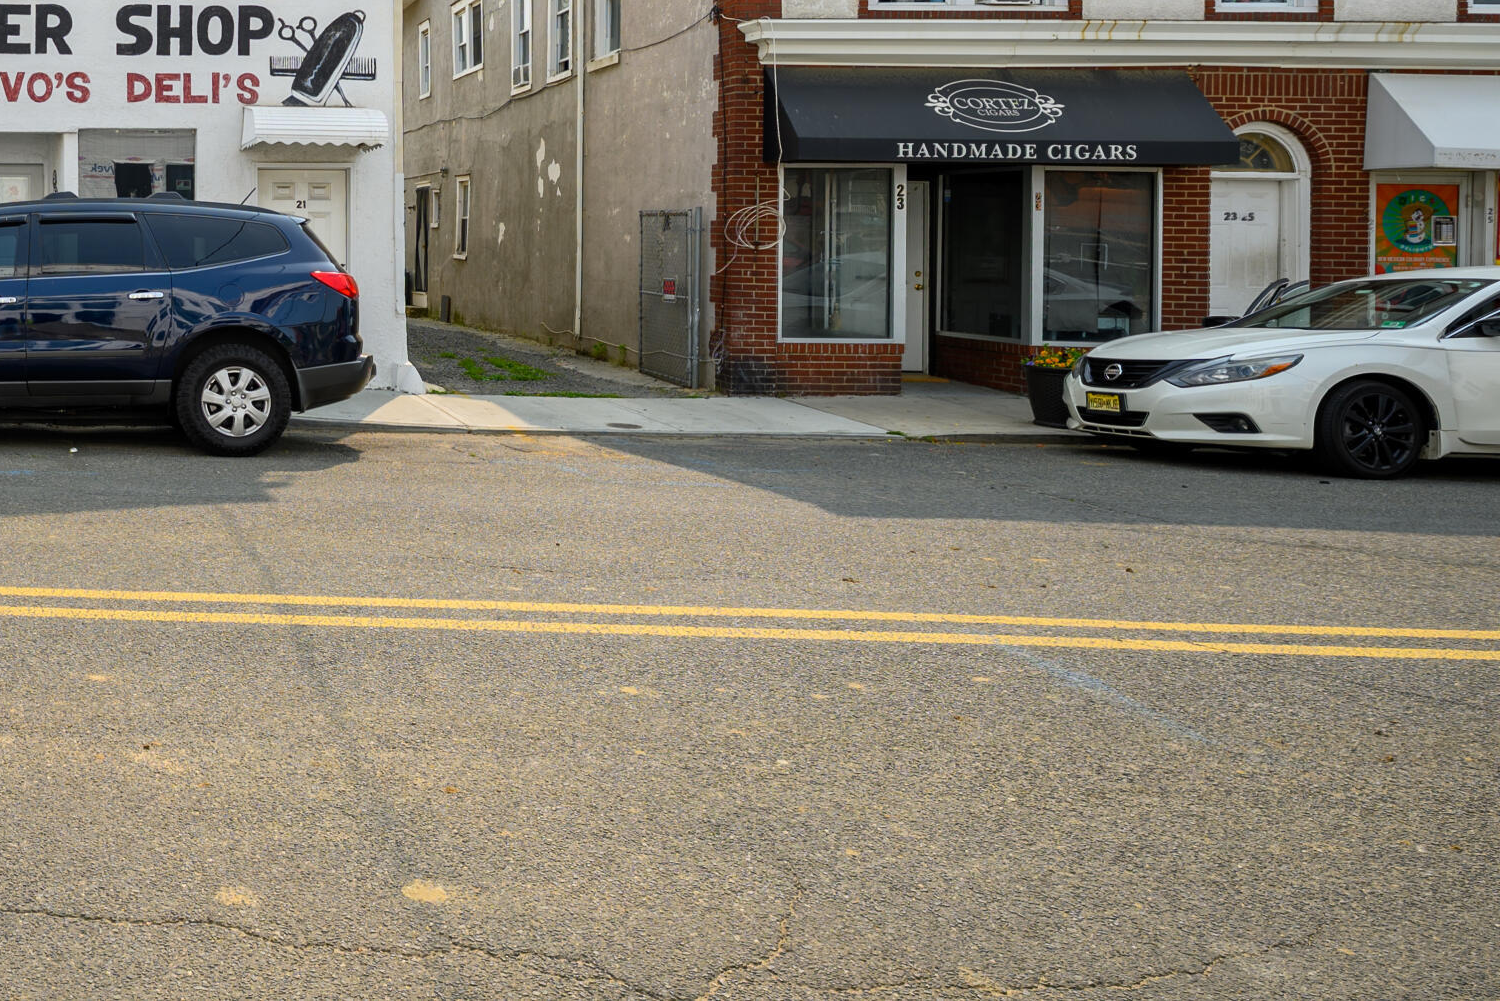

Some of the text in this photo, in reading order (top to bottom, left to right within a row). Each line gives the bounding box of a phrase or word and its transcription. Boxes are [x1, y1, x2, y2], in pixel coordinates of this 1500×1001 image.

[116, 4, 275, 56] SHOP
[126, 72, 260, 104] DELI'S
[977, 109, 1020, 117] CIGARS
[896, 142, 1138, 160] HANDMADE CIGARS
[296, 200, 306, 209] 21
[896, 184, 905, 210] 23
[1223, 212, 1237, 221] 23
[1487, 208, 1494, 224] 25
